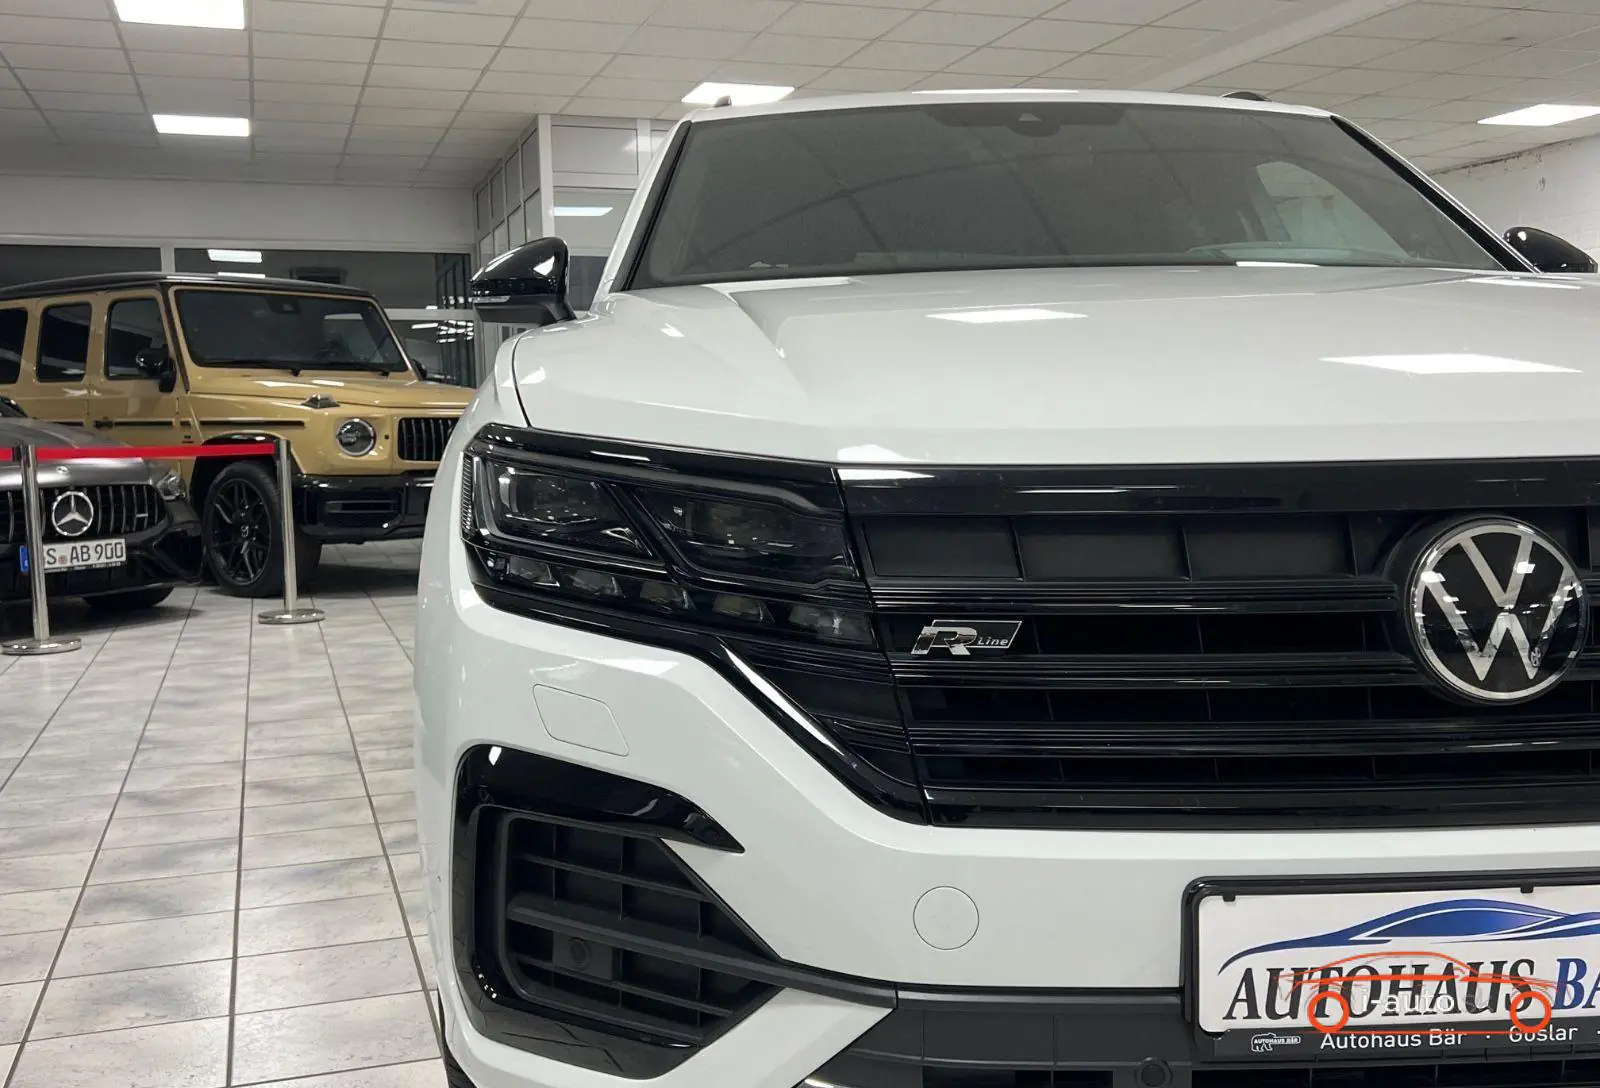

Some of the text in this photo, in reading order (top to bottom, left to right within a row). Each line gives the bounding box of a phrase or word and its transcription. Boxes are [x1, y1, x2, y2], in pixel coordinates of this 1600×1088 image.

[42, 542, 124, 565] S AB 900
[1222, 958, 1535, 1020] AUTOHAUS
[1320, 1023, 1578, 1049] Autohaus Bär Goslar
